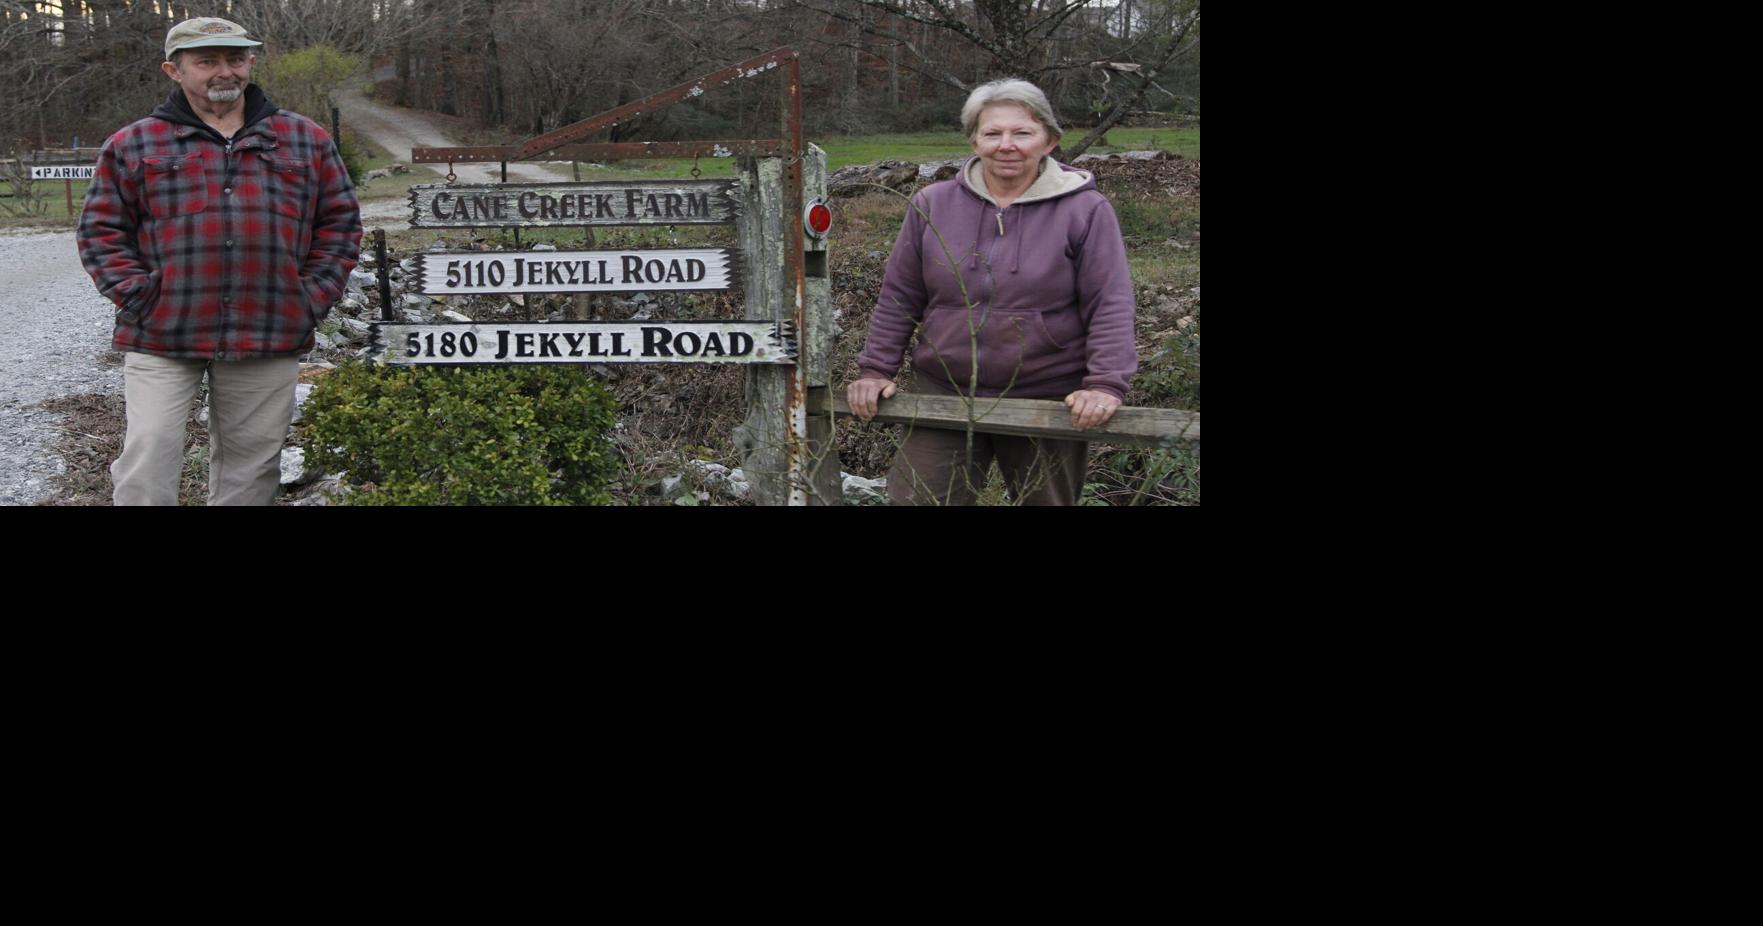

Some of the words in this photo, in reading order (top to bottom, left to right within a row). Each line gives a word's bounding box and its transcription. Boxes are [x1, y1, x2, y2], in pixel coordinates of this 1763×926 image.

[43, 167, 96, 178] PARKIN
[431, 192, 508, 220] CANE
[517, 191, 614, 219] CREEK
[624, 188, 710, 219] FARM
[446, 259, 505, 288] 5110
[513, 257, 614, 287] JEKYLL
[621, 255, 706, 283] ROAD
[406, 331, 478, 358] 5180
[495, 330, 631, 360] JEKYLL
[641, 326, 754, 357] ROAD
